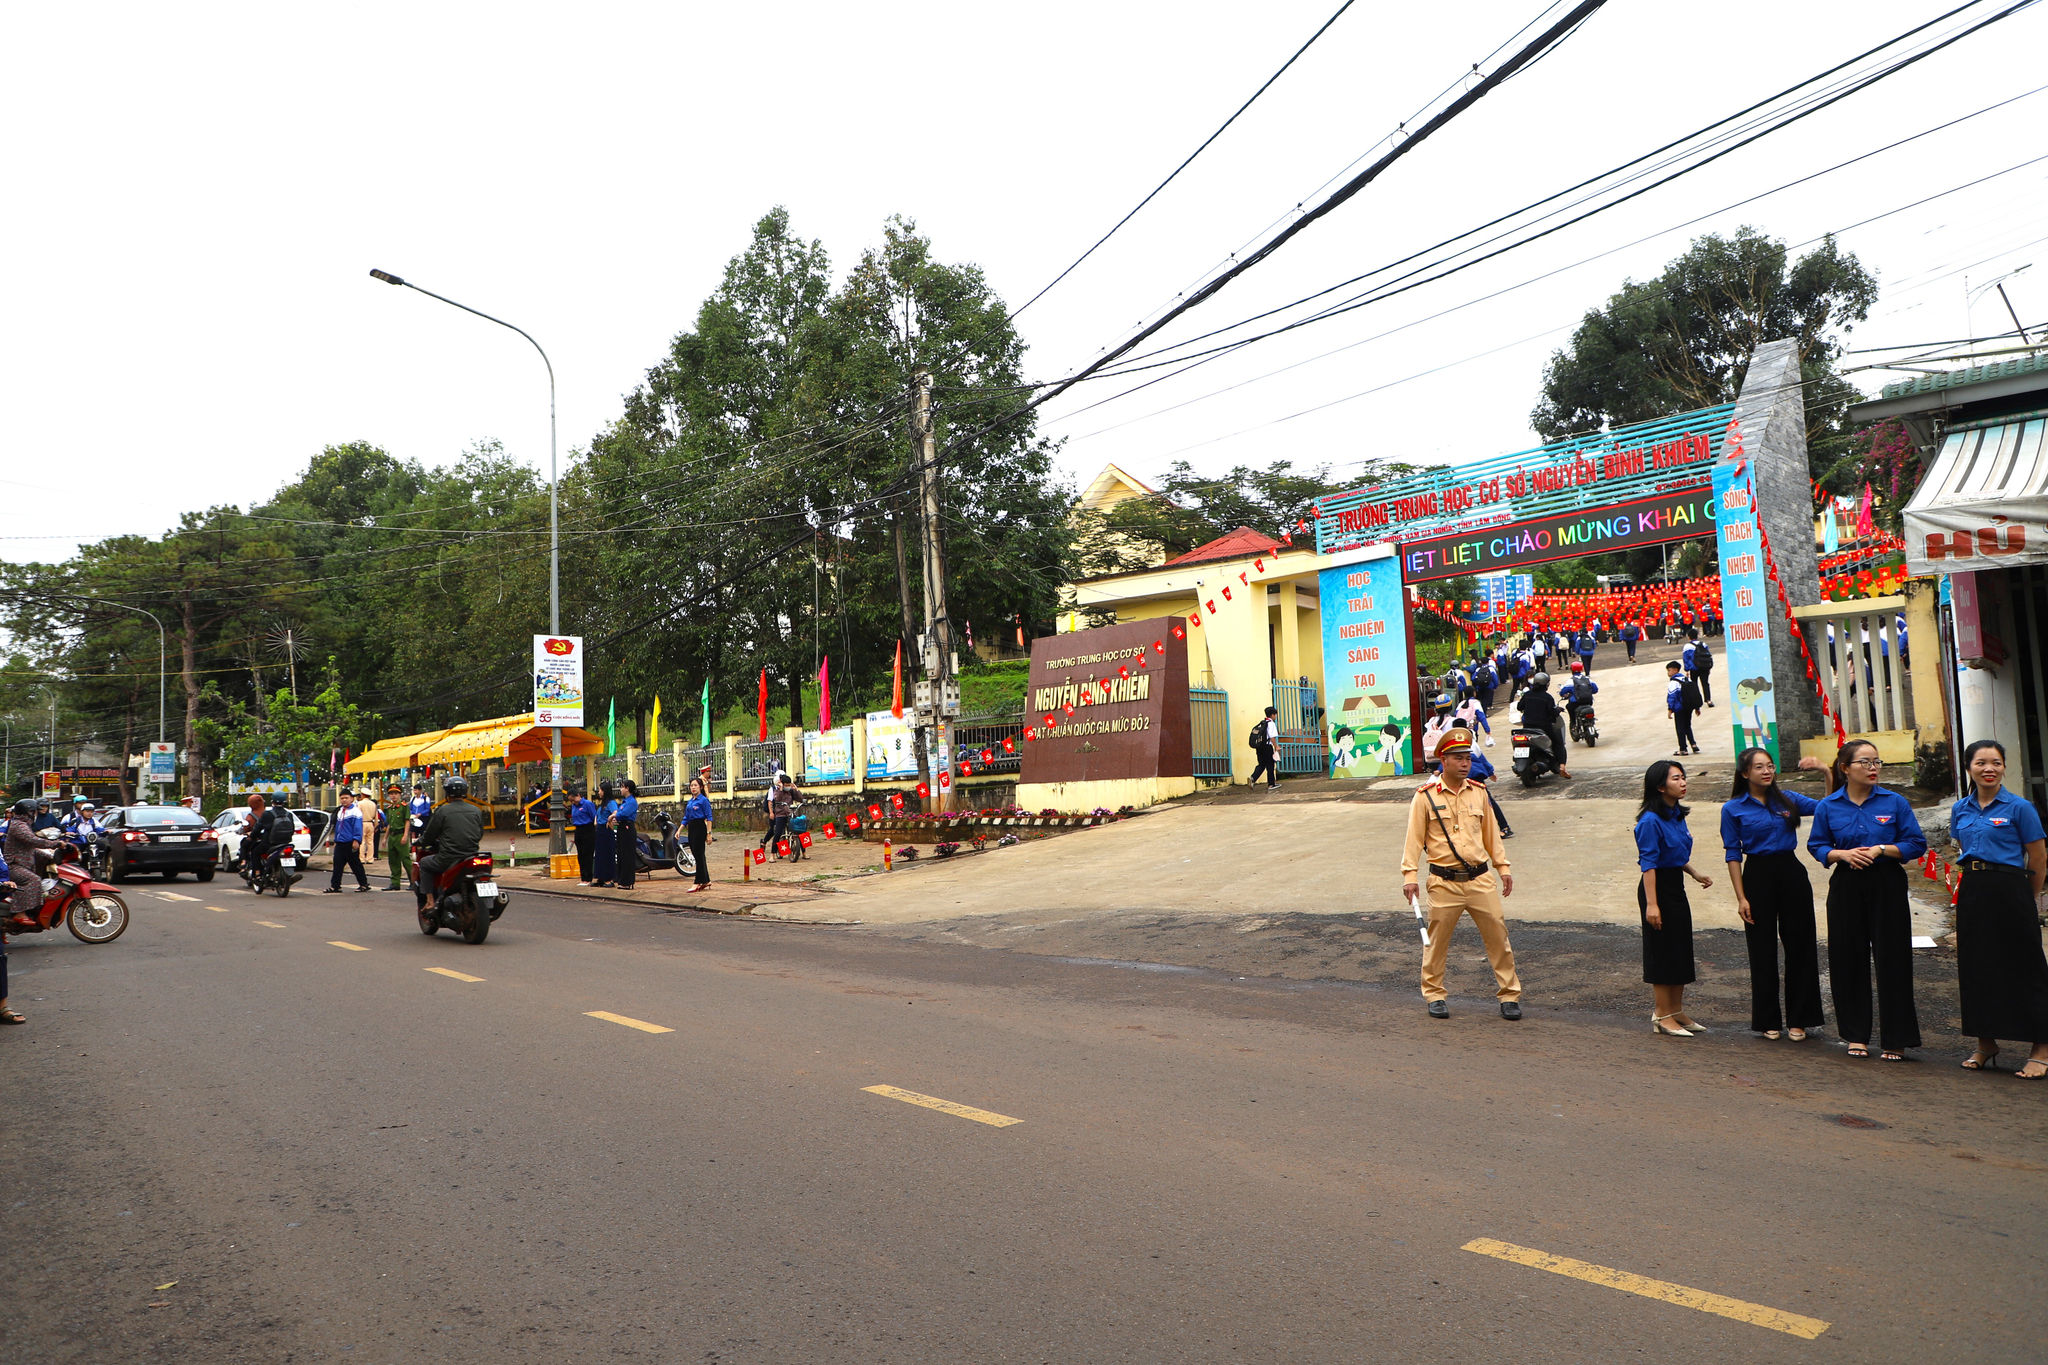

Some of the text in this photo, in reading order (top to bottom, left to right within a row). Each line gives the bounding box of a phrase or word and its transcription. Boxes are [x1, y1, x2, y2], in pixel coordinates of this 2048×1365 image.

[1337, 502, 1389, 533] TRƯỜNG
[1394, 492, 1439, 522] TRUNG
[1443, 484, 1473, 515] HỌC
[1479, 476, 1501, 504] CƠ
[1505, 465, 1526, 499] SỞ
[1532, 450, 1598, 494] NGUYỄN
[1652, 432, 1711, 470] KHIÊM
[1723, 484, 1747, 509] SỐNG
[1442, 541, 1485, 566] LIỆT
[1490, 529, 1552, 559] CHÀO
[1557, 515, 1631, 547] MỪNG
[1638, 503, 1696, 533] KHAI
[1724, 520, 1753, 542] TRÁCH
[1923, 514, 2027, 562] HỦ
[1727, 552, 1756, 577] NHIỆM
[1347, 571, 1371, 589] HỌC
[1347, 592, 1373, 612] TRẢI
[1735, 586, 1753, 607] YÊU
[1339, 619, 1385, 639] NGHIỆM
[1729, 621, 1764, 642] THƯƠNG
[1046, 656, 1076, 670] TRƯỜNG
[1077, 653, 1102, 665] TRUNG
[1102, 648, 1119, 663] HỌC
[1120, 647, 1133, 659] CƠ
[1347, 646, 1379, 663] SÁNG
[1034, 676, 1079, 712] NGUYỄN
[1110, 671, 1150, 704] KHIÊM
[1354, 673, 1376, 691] TẠO
[539, 713, 552, 723] 5G
[1073, 718, 1096, 737] QUỐC
[1096, 721, 1110, 735] GIA
[1111, 716, 1130, 733] MỨC
[1143, 716, 1150, 730] 2
